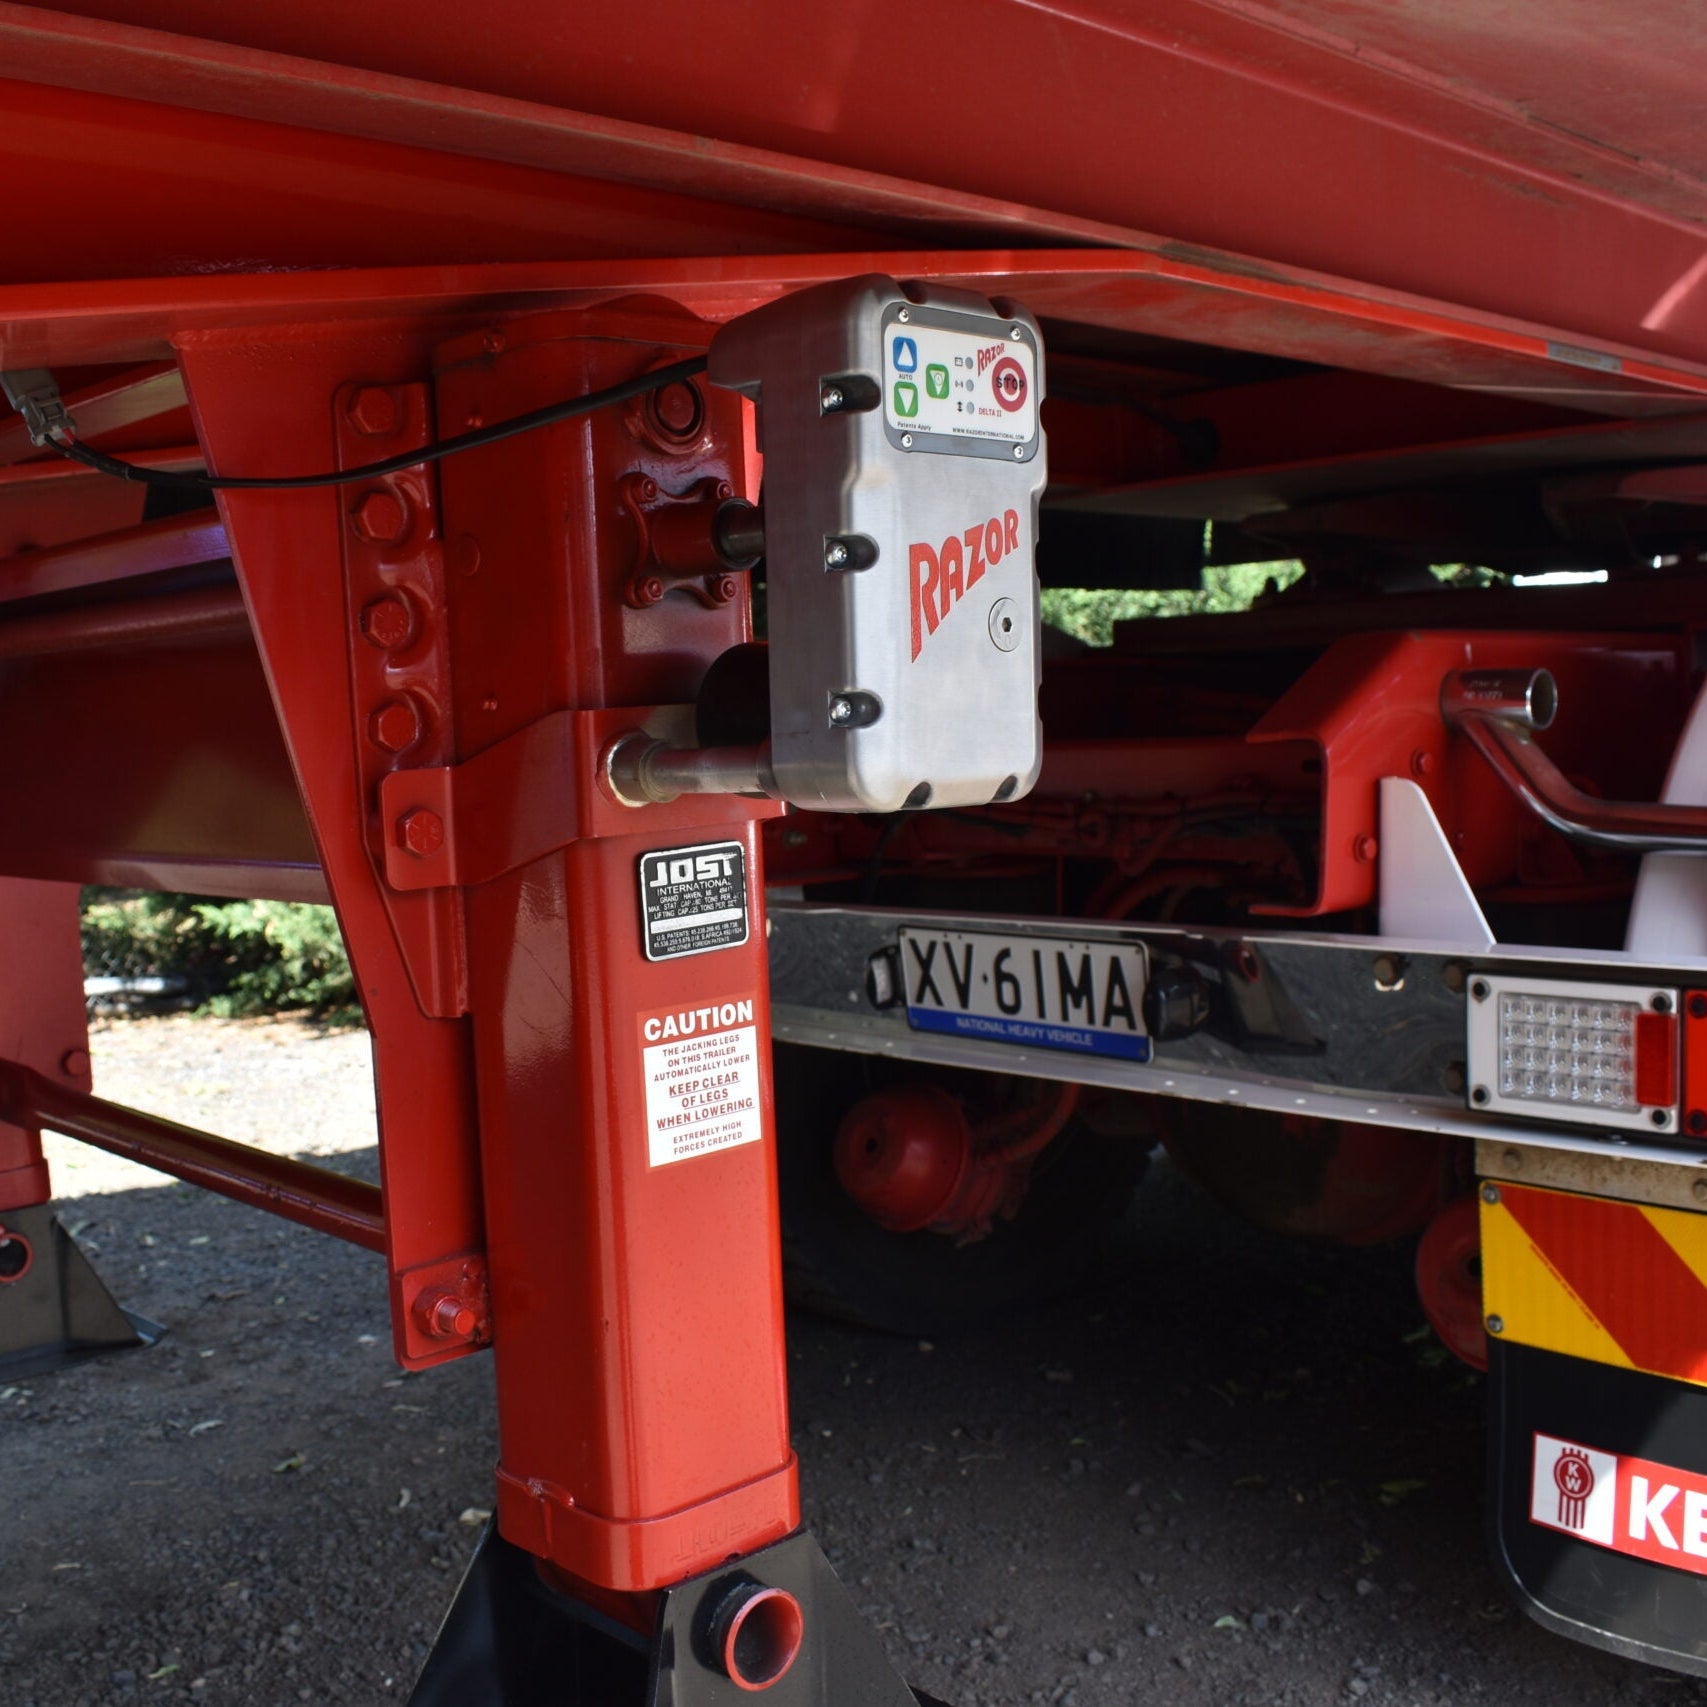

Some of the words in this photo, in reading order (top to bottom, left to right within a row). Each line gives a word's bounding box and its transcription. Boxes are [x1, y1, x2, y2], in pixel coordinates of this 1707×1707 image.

[977, 343, 1005, 378] RAZOR
[996, 377, 1024, 391] STOP
[978, 407, 996, 417] DELTA
[897, 421, 916, 429] Patents
[909, 509, 1019, 663] RAZOR
[650, 853, 737, 887] JOST
[657, 878, 732, 896] INTERNATIONAL
[660, 895, 678, 904] GRAND
[654, 910, 675, 920] LIFTING
[644, 1000, 753, 1041] CAUTION
[956, 1017, 1006, 1036] NATIONAL
[1007, 1023, 1046, 1040] HEAVY
[1046, 1028, 1093, 1046] VEHICLE
[663, 1047, 679, 1057] THE
[681, 1039, 717, 1053] JACKING
[719, 1034, 740, 1045] LEGS
[668, 1058, 680, 1067] ON
[682, 1054, 701, 1064] THIS
[704, 1046, 736, 1059] TRAILER
[654, 1060, 721, 1082] AUTOMATICALLY
[723, 1054, 750, 1067] LOWER
[669, 1080, 699, 1097] KEEP
[702, 1071, 739, 1089] CLEAR
[681, 1096, 696, 1108] OF
[700, 1088, 729, 1104] LEGS
[657, 1112, 691, 1129] WHEN
[695, 1097, 753, 1120] LOWERING
[673, 1126, 720, 1144] EXTREMELY
[722, 1121, 742, 1132] HIGH
[673, 1142, 705, 1155] FORCES
[707, 1131, 743, 1146] CREATED
